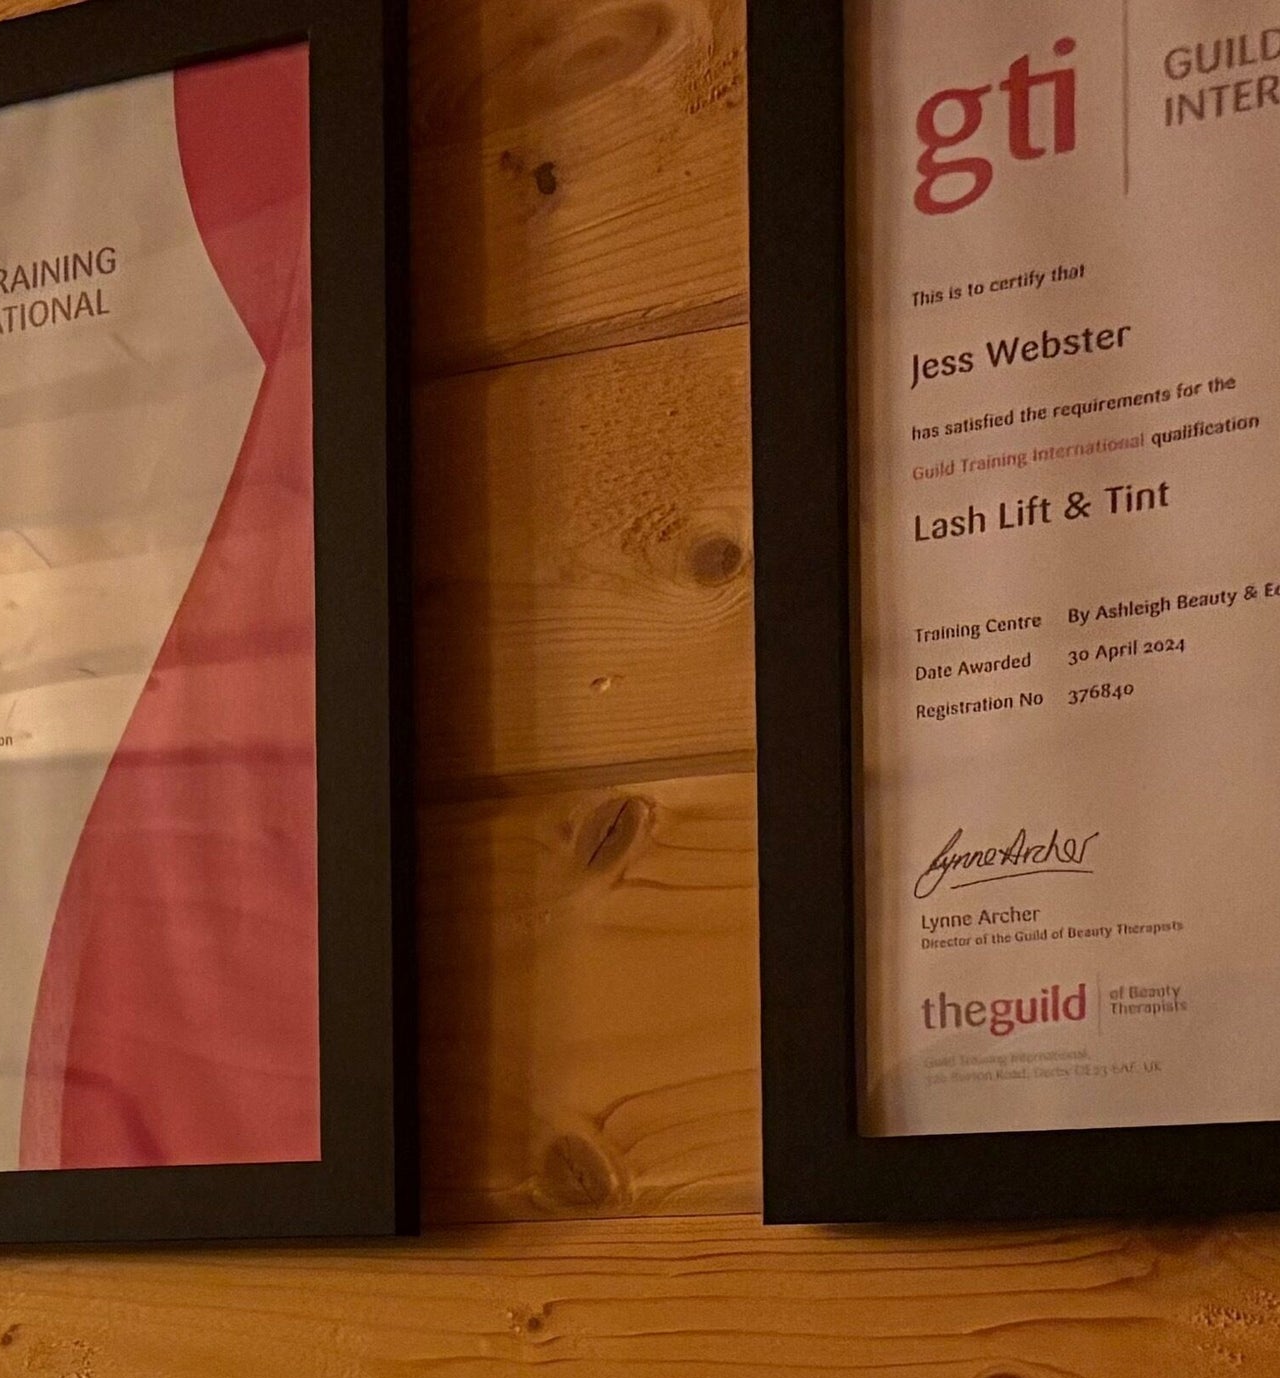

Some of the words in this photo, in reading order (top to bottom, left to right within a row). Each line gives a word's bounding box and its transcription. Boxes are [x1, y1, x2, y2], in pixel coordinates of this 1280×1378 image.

[1164, 28, 1280, 81] GUILD
[913, 36, 1076, 216] gti
[912, 291, 943, 306] This
[949, 286, 962, 299] is
[968, 284, 984, 297] to
[990, 271, 1045, 292] certify
[1051, 264, 1085, 281] that
[911, 352, 974, 389] Jess
[986, 326, 1131, 367] Webster
[912, 425, 939, 441] has
[945, 410, 1014, 435] satisfied
[1021, 406, 1046, 423] the
[1053, 389, 1170, 418] requirements
[1177, 382, 1200, 398] for
[1208, 376, 1236, 393] the
[913, 463, 955, 481] Guild
[961, 451, 1027, 473] Training
[1033, 434, 1144, 462] International
[1152, 415, 1260, 448] qualification
[915, 505, 986, 541] Lash
[999, 496, 1051, 530] Lift
[1064, 491, 1091, 519] &
[1104, 481, 1169, 514] Tint
[916, 623, 980, 643] Training
[986, 615, 1041, 633] Centre
[1068, 609, 1090, 626] By
[1095, 598, 1170, 621] Ashleigh
[1177, 590, 1237, 610] Beauty
[1244, 585, 1257, 599] &
[916, 664, 952, 681] Date
[958, 653, 1031, 676] Awarded
[1068, 651, 1089, 665] 30
[1095, 640, 1137, 660] April
[1144, 638, 1185, 653] 2024
[916, 697, 1013, 721] Registration
[1019, 693, 1043, 707] No
[1068, 683, 1134, 705] 376840
[921, 911, 972, 933] Lynne
[978, 906, 1040, 925] Archer
[921, 936, 970, 950] Director
[975, 934, 989, 946] of
[991, 933, 1011, 944] the
[1015, 930, 1047, 943] Guild
[1052, 928, 1065, 940] of
[1068, 925, 1112, 941] Beauty
[1117, 921, 1184, 937] Therapists
[1109, 987, 1125, 1001] of
[1129, 984, 1181, 1001] Beauty
[1110, 1000, 1188, 1018] Therapists
